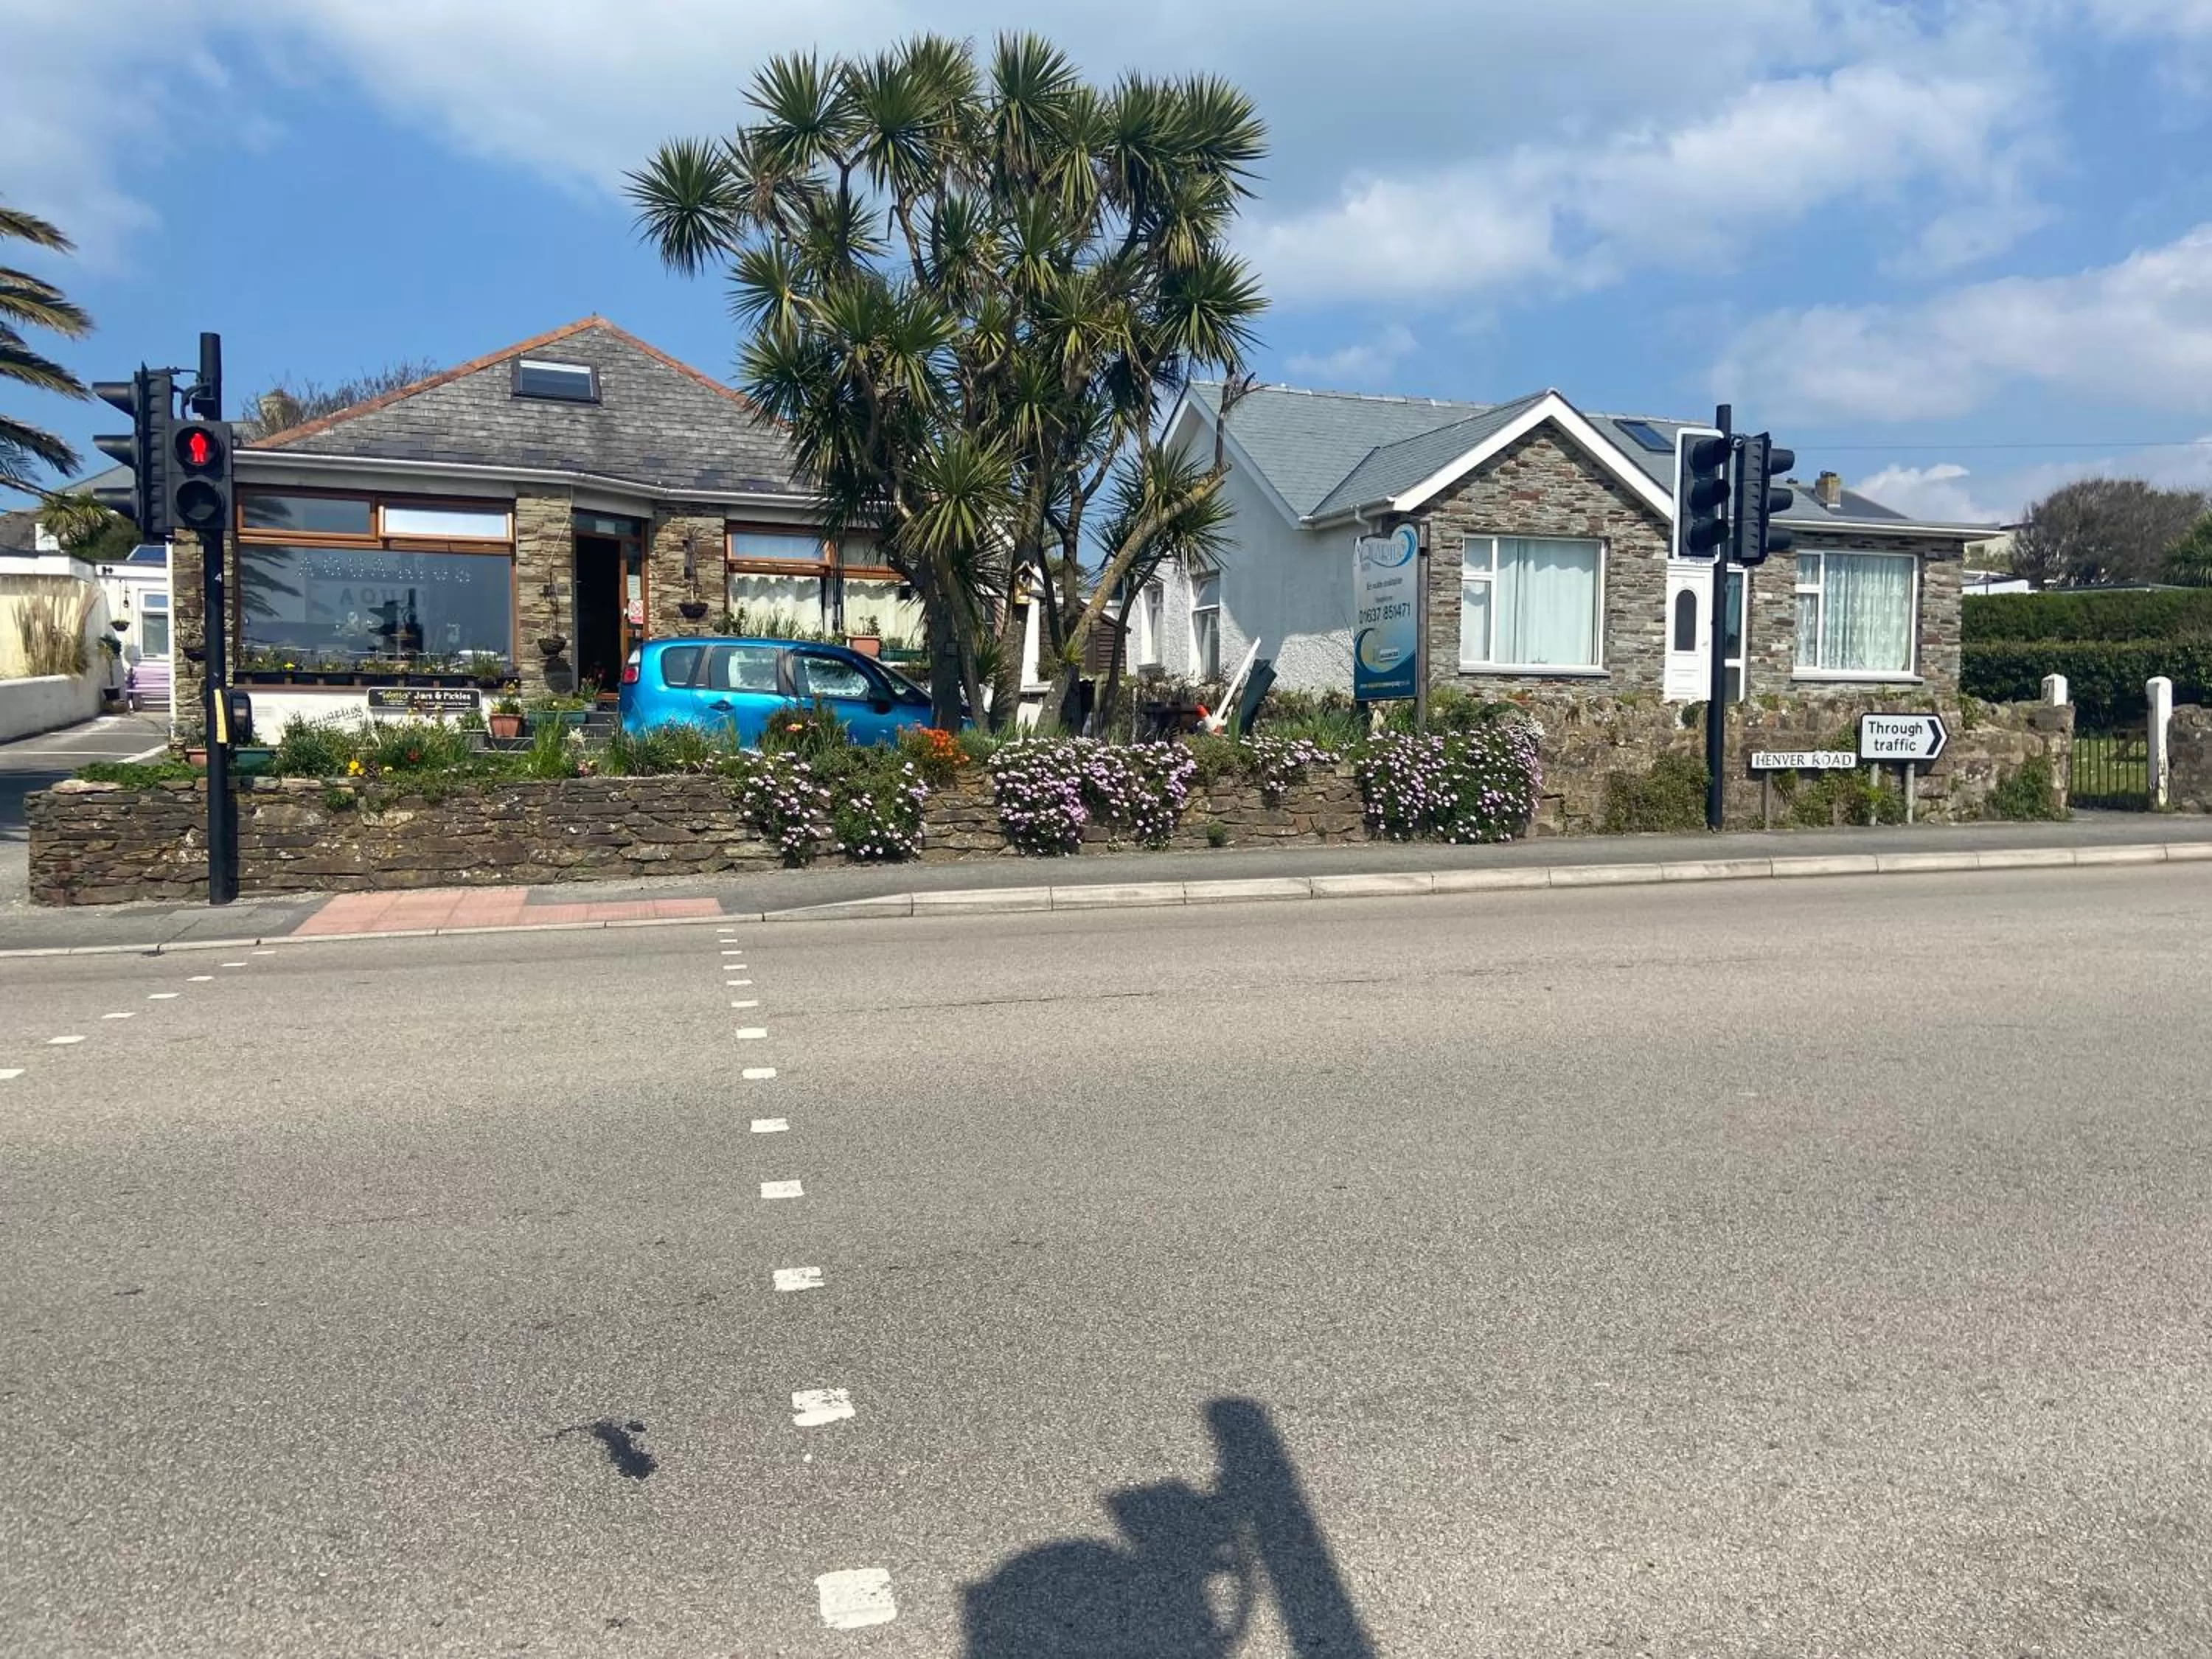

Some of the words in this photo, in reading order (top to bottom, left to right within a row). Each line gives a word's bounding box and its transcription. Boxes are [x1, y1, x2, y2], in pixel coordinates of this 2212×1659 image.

[443, 691, 471, 700] Pickles
[1868, 721, 1923, 736] Through
[1874, 739, 1916, 751] traffic
[1756, 754, 1805, 766] HENVER
[1812, 754, 1852, 766] ROAD
